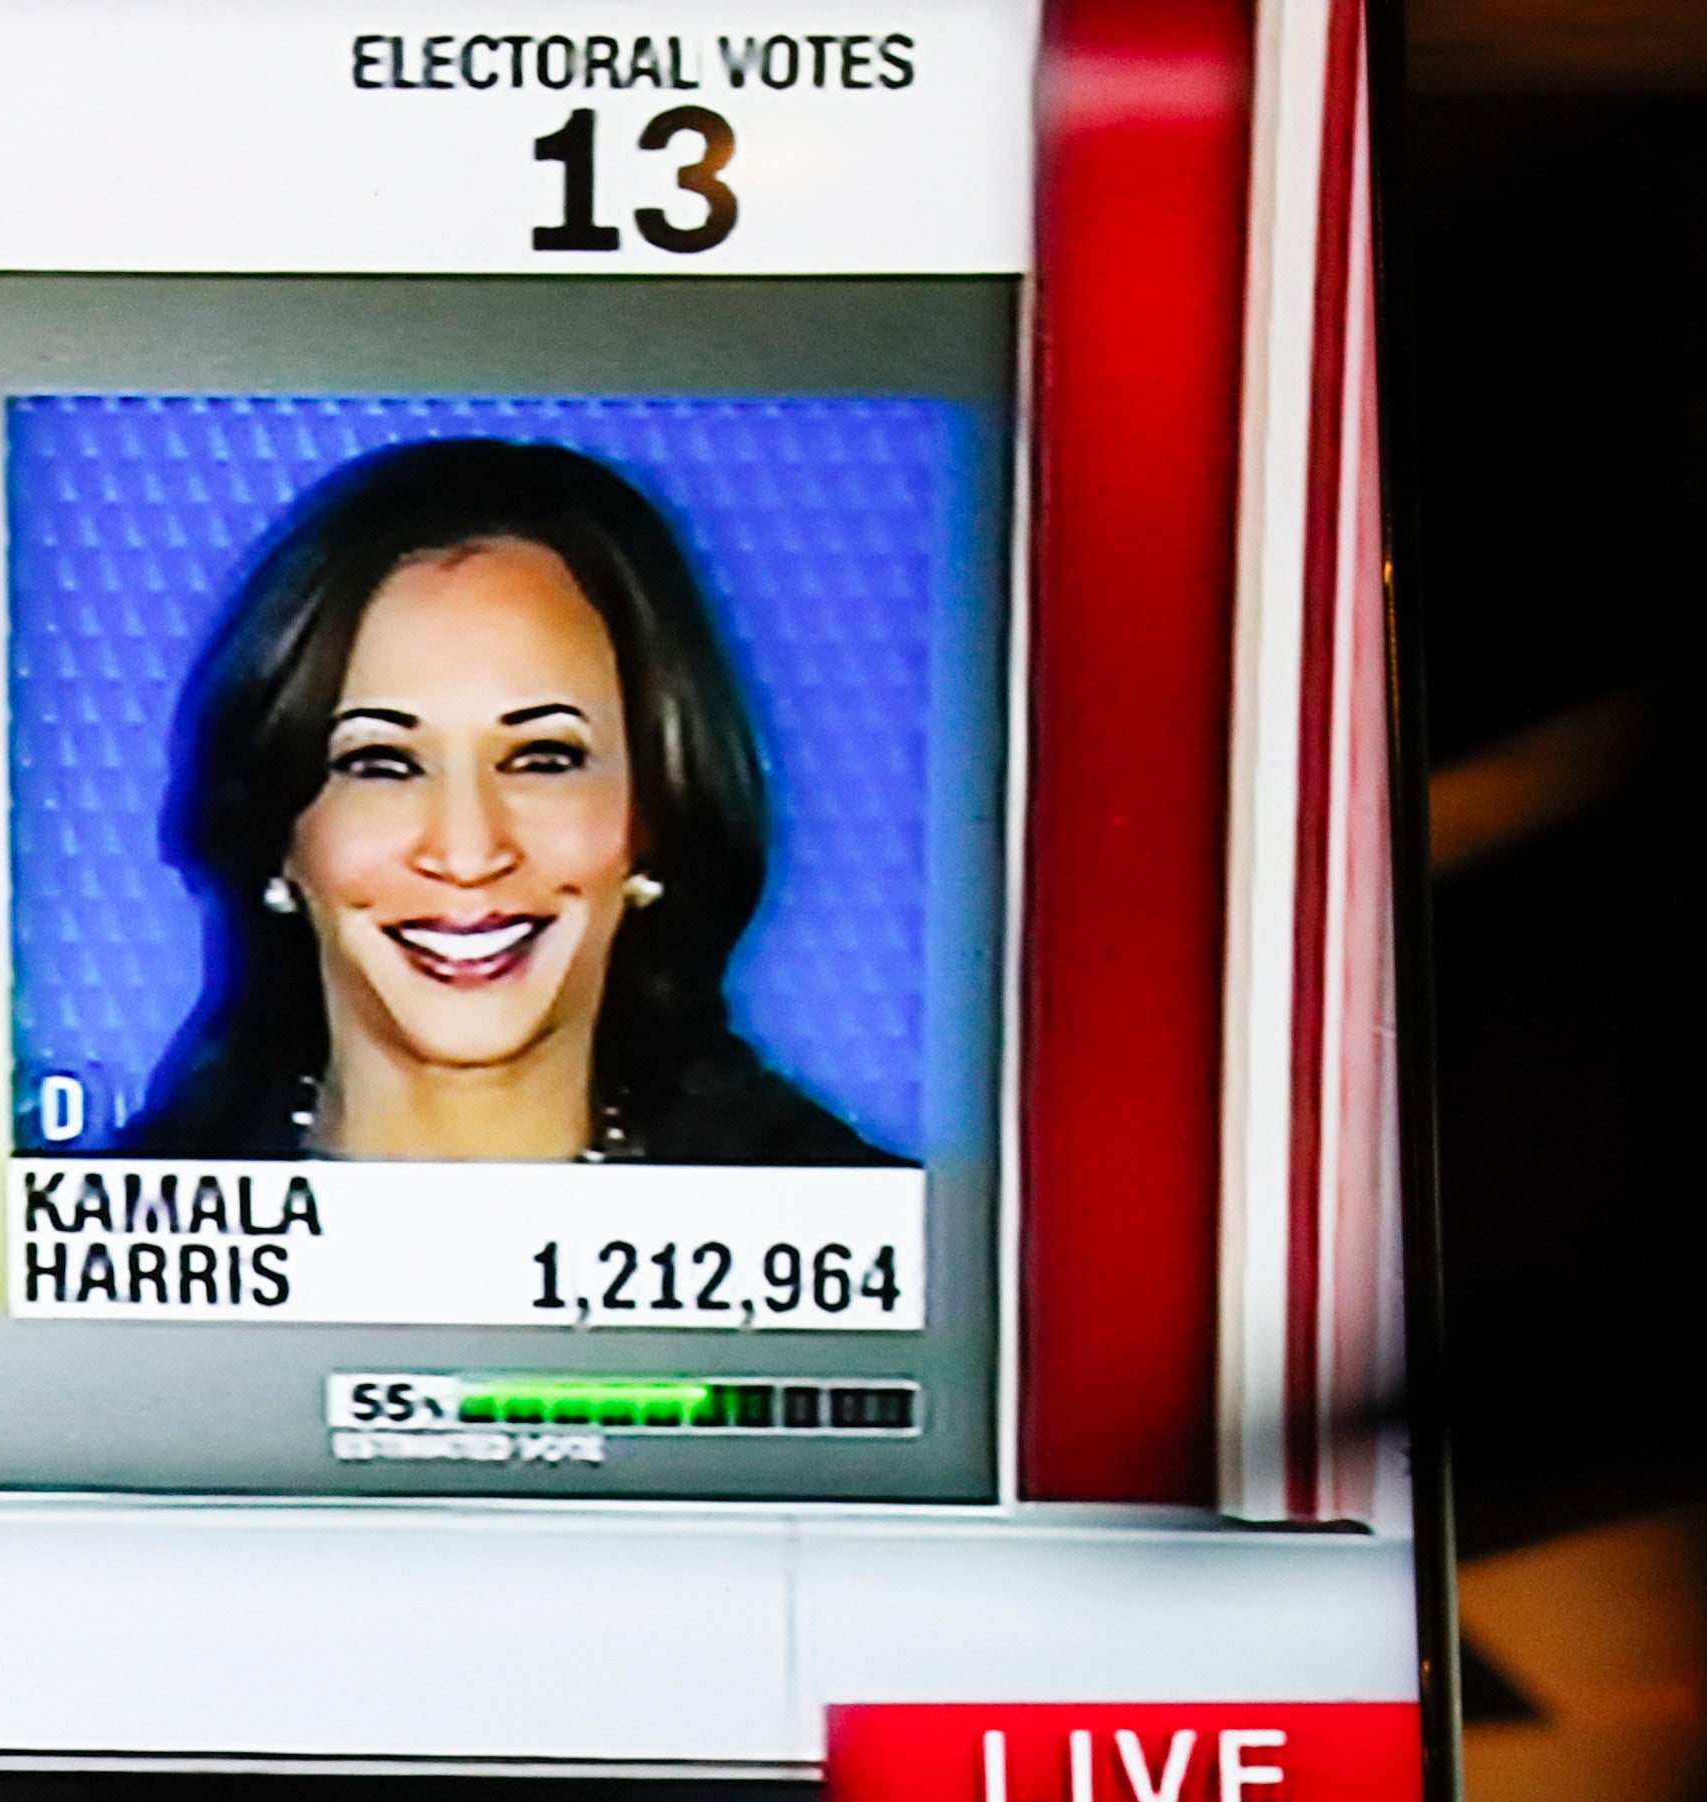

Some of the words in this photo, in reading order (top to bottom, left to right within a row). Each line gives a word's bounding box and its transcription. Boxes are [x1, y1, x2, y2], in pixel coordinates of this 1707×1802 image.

[352, 34, 700, 91] ELECTORAL
[718, 33, 915, 91] VOTES
[531, 104, 738, 254] 13
[39, 1074, 84, 1142] D
[24, 1171, 322, 1236] KAMALA
[25, 1241, 290, 1307] HARRIS
[532, 1240, 901, 1326] 1,212,964
